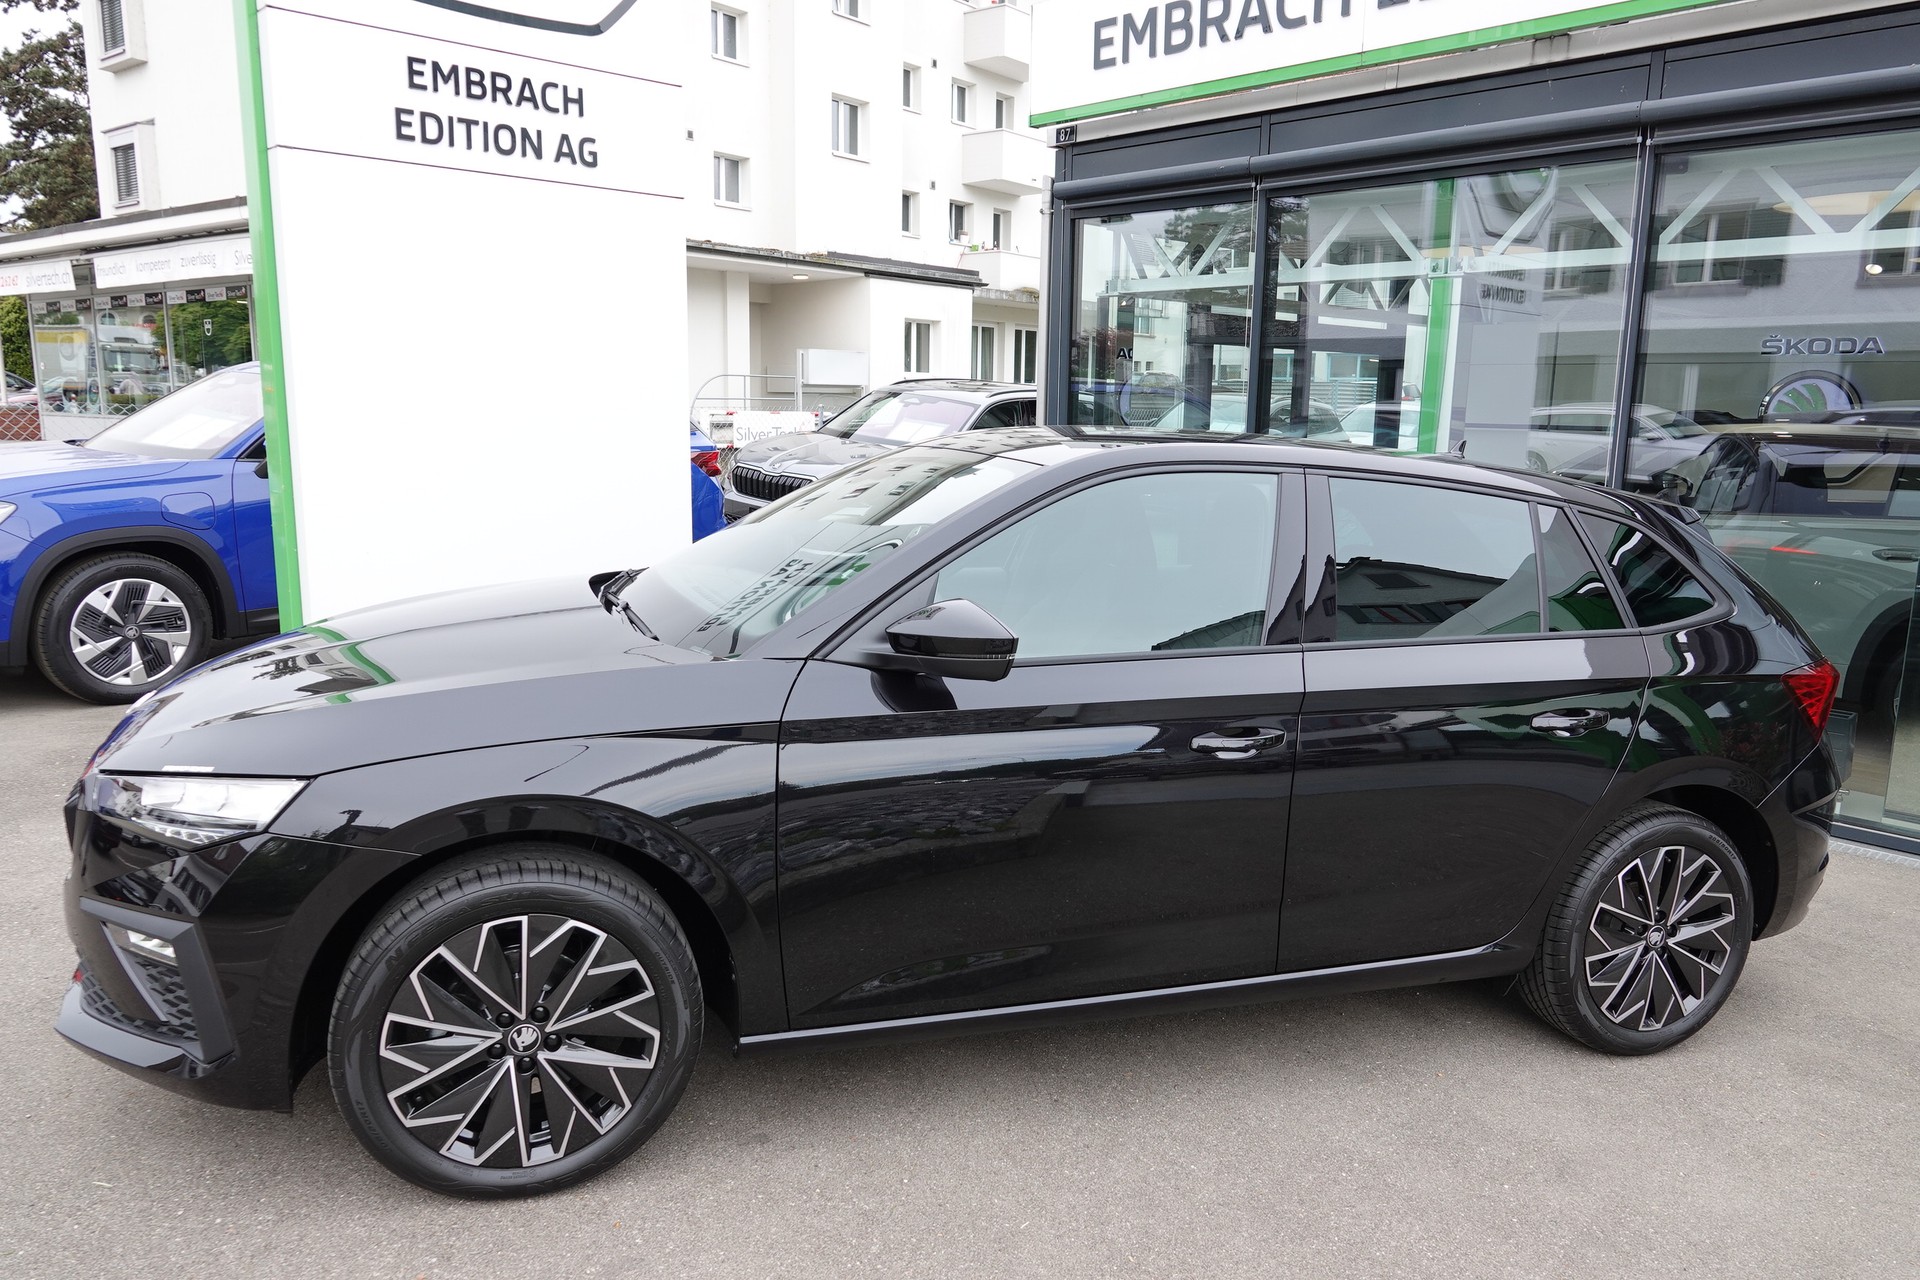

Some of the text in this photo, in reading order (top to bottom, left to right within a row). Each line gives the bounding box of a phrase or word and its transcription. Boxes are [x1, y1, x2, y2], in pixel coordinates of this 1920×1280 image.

[406, 55, 584, 118] EMBRACH
[394, 106, 598, 168] EDITION AG
[1060, 128, 1071, 142] 87
[1760, 334, 1885, 356] ŠKODA
